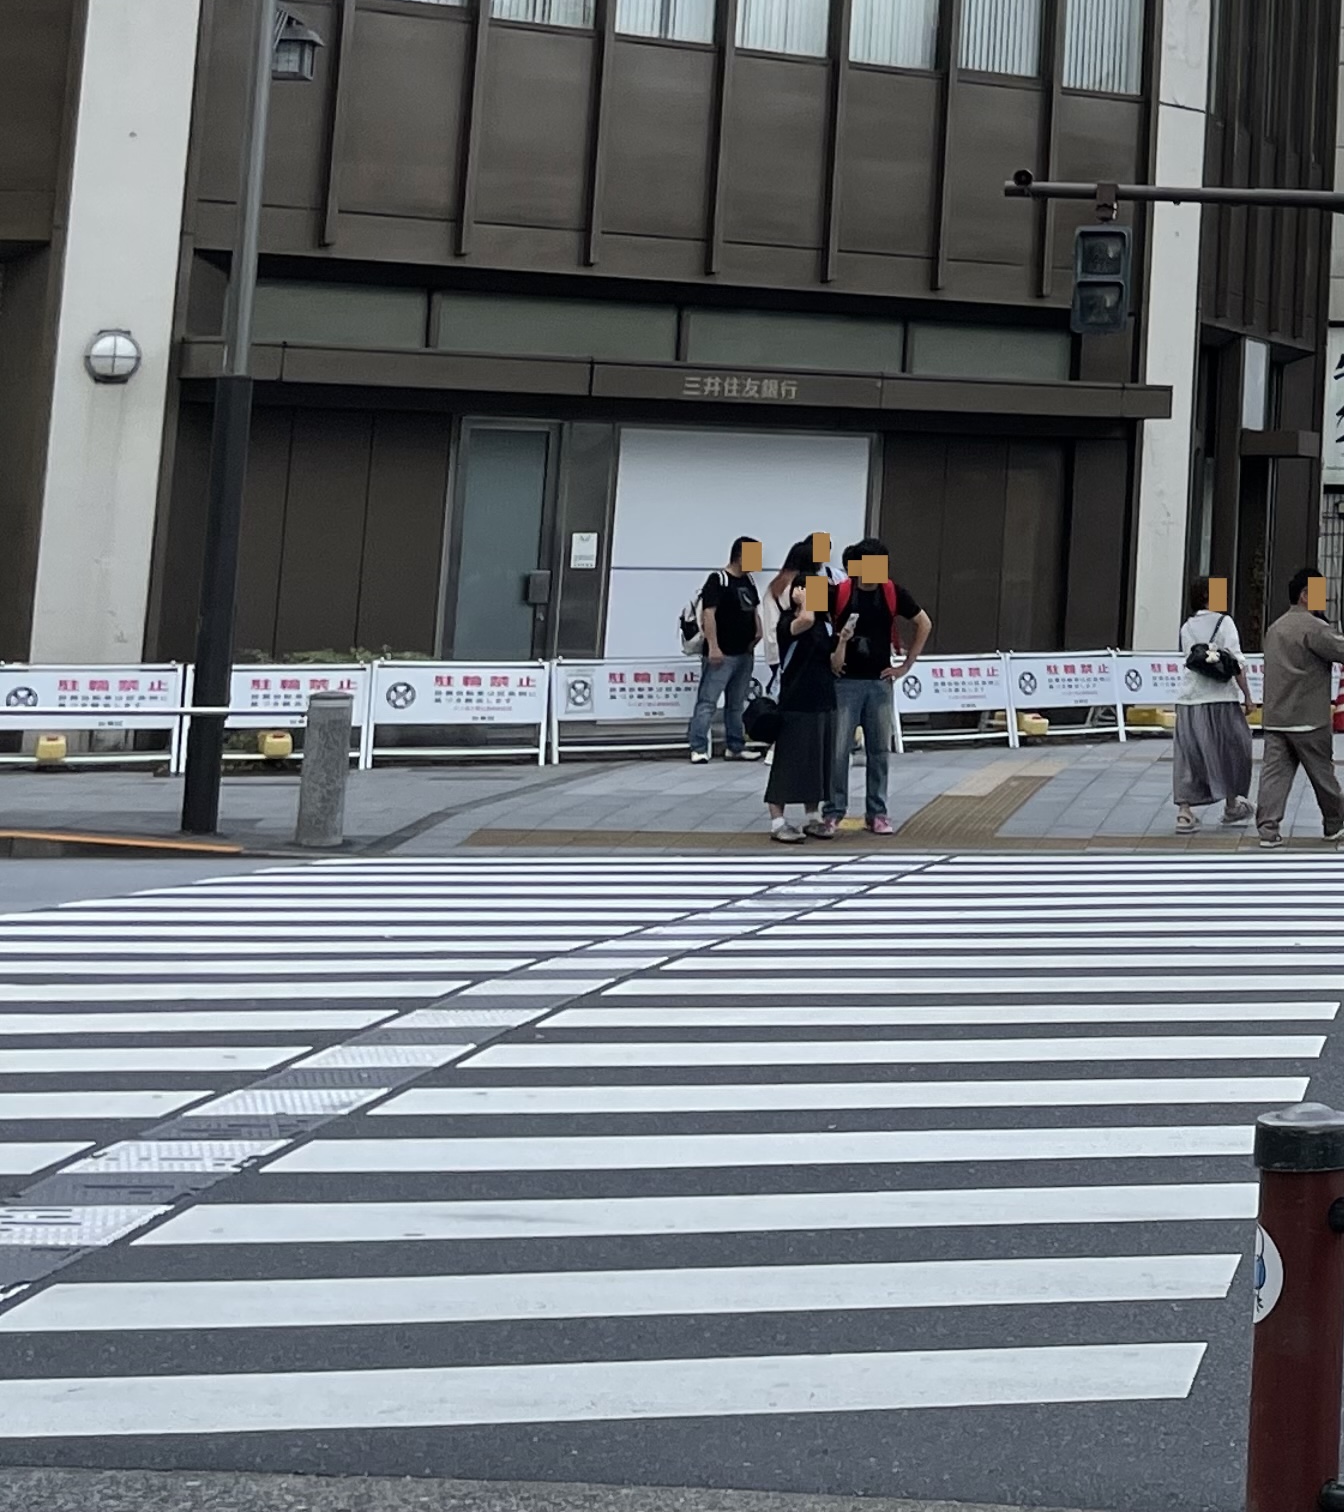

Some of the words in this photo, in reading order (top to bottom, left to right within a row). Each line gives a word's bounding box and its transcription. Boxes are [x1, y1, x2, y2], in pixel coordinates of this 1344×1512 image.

[682, 376, 799, 400] 三井住友銀行
